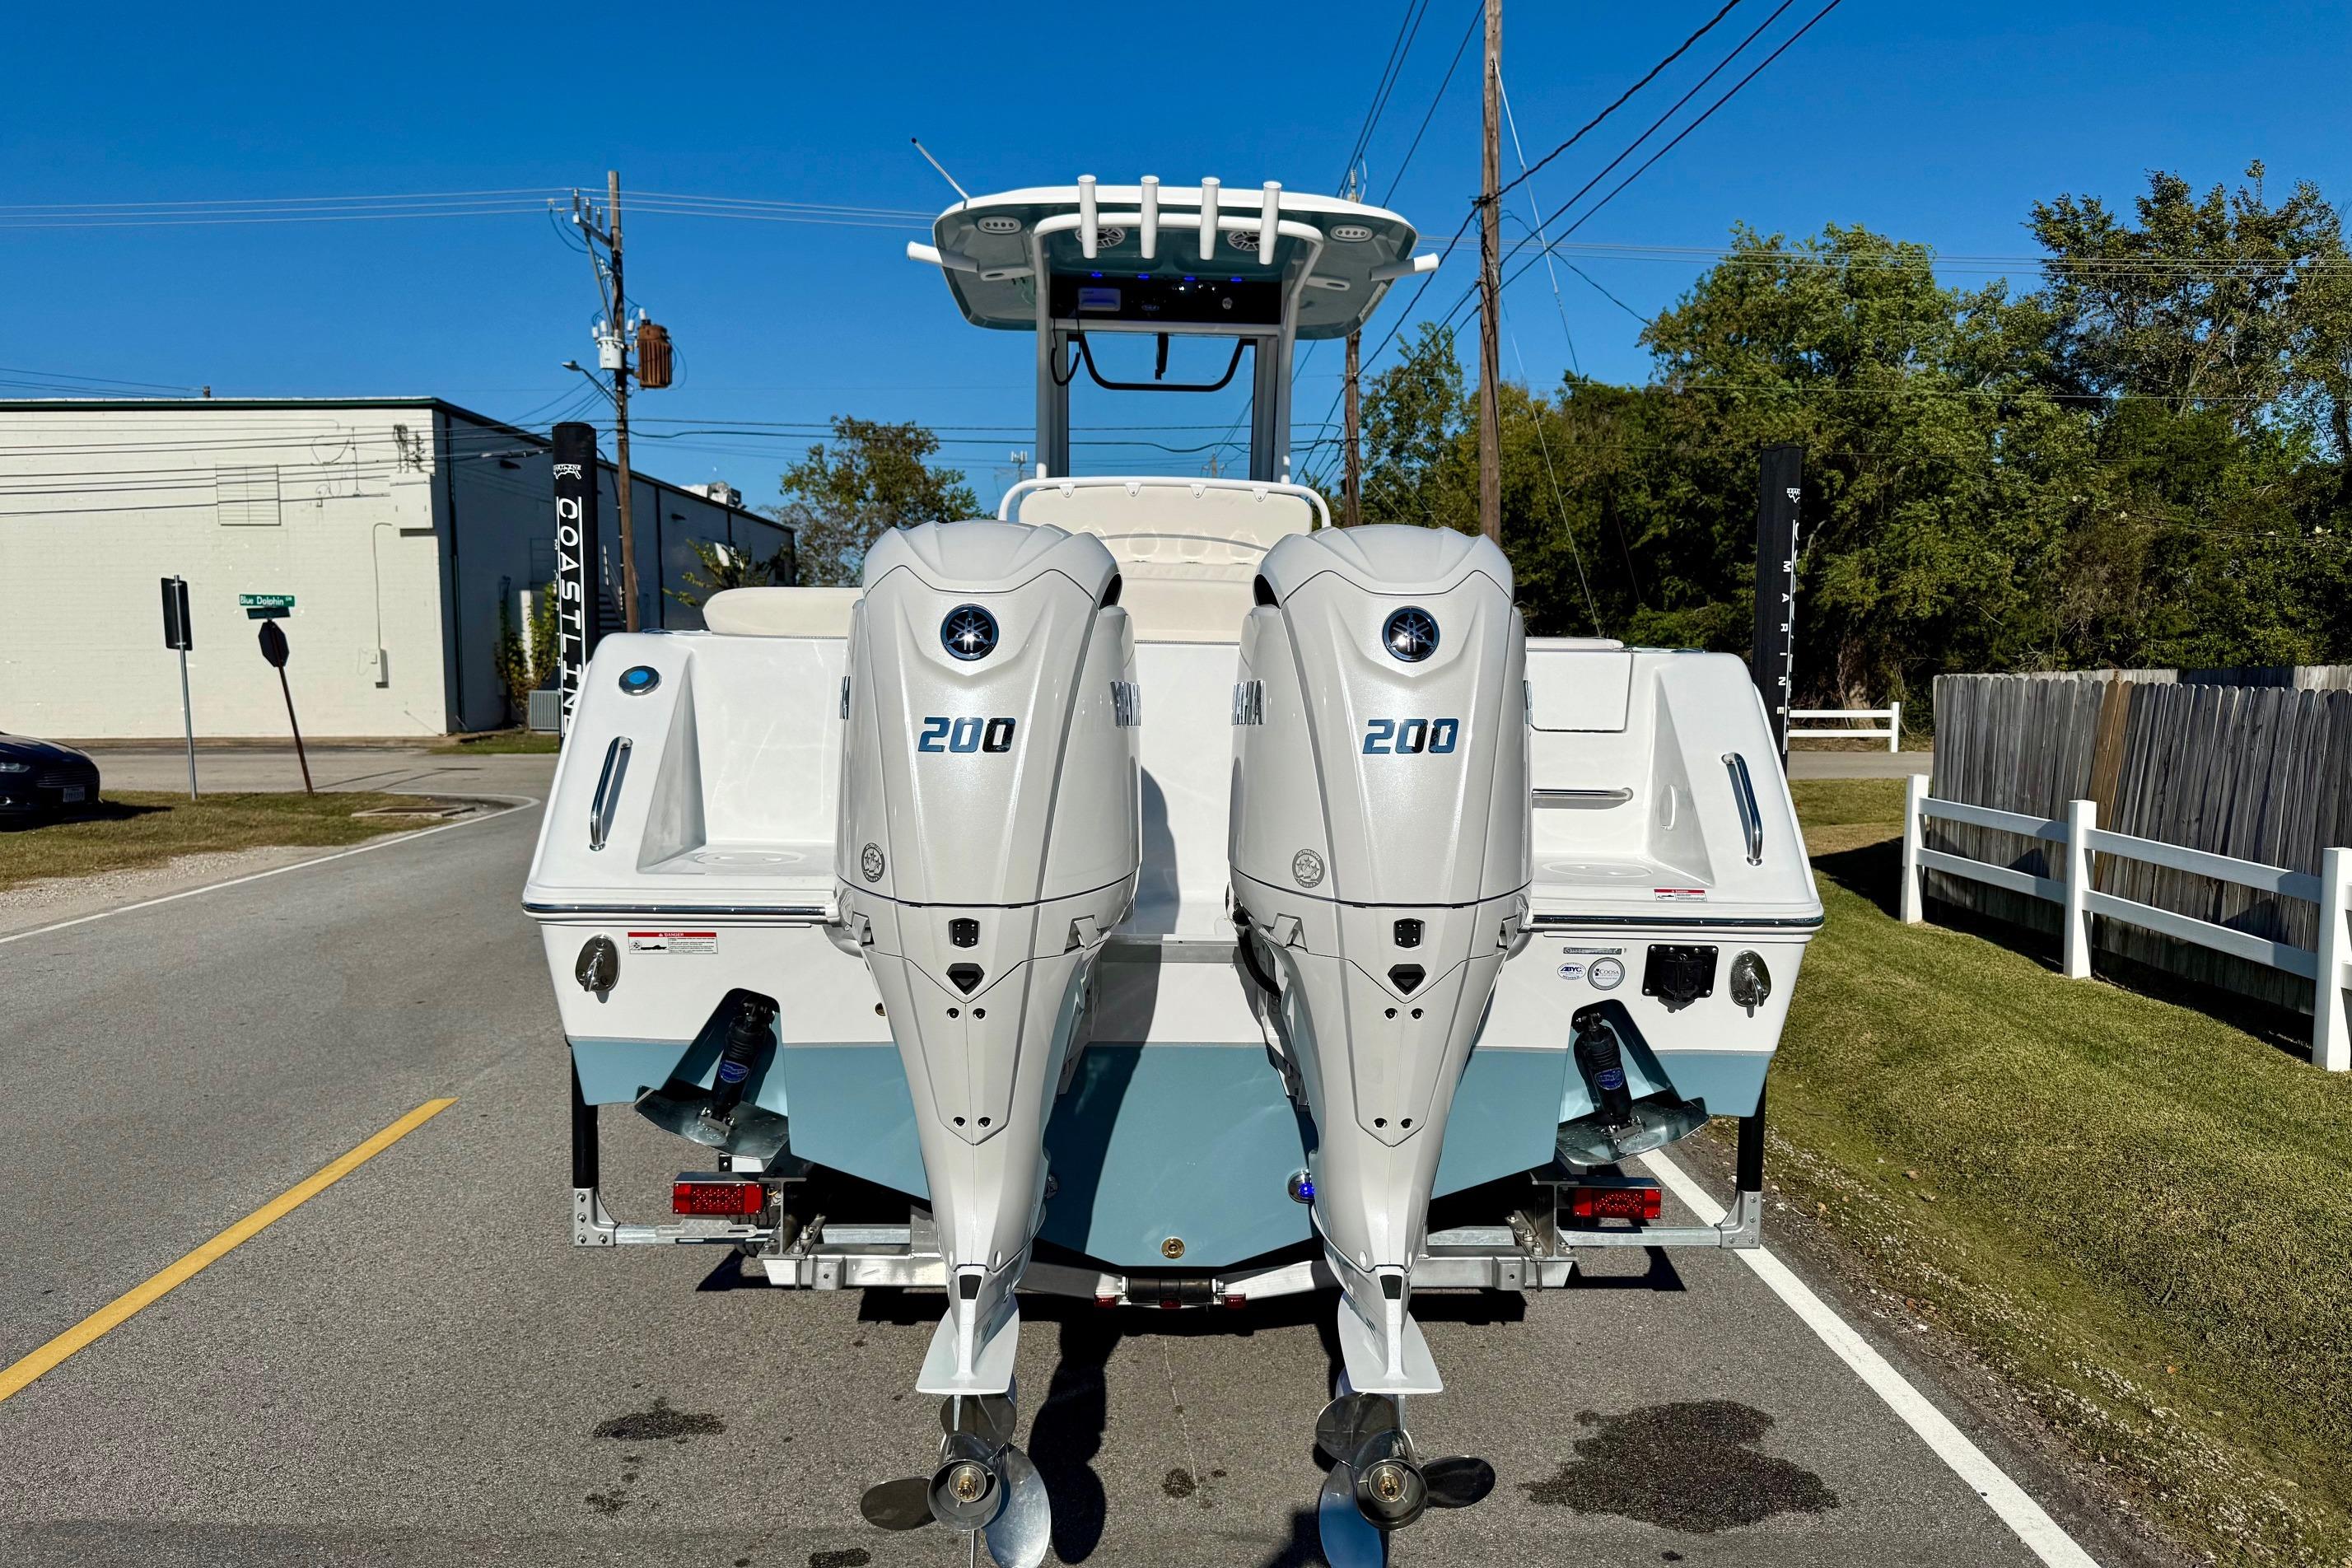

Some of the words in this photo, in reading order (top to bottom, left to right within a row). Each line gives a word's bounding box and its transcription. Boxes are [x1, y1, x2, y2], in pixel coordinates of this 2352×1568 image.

[240, 595, 254, 604] Blue
[256, 595, 284, 607] Dolphin
[1776, 561, 1792, 715] MARINE
[917, 716, 1017, 754] 200
[1361, 717, 1459, 754] 200
